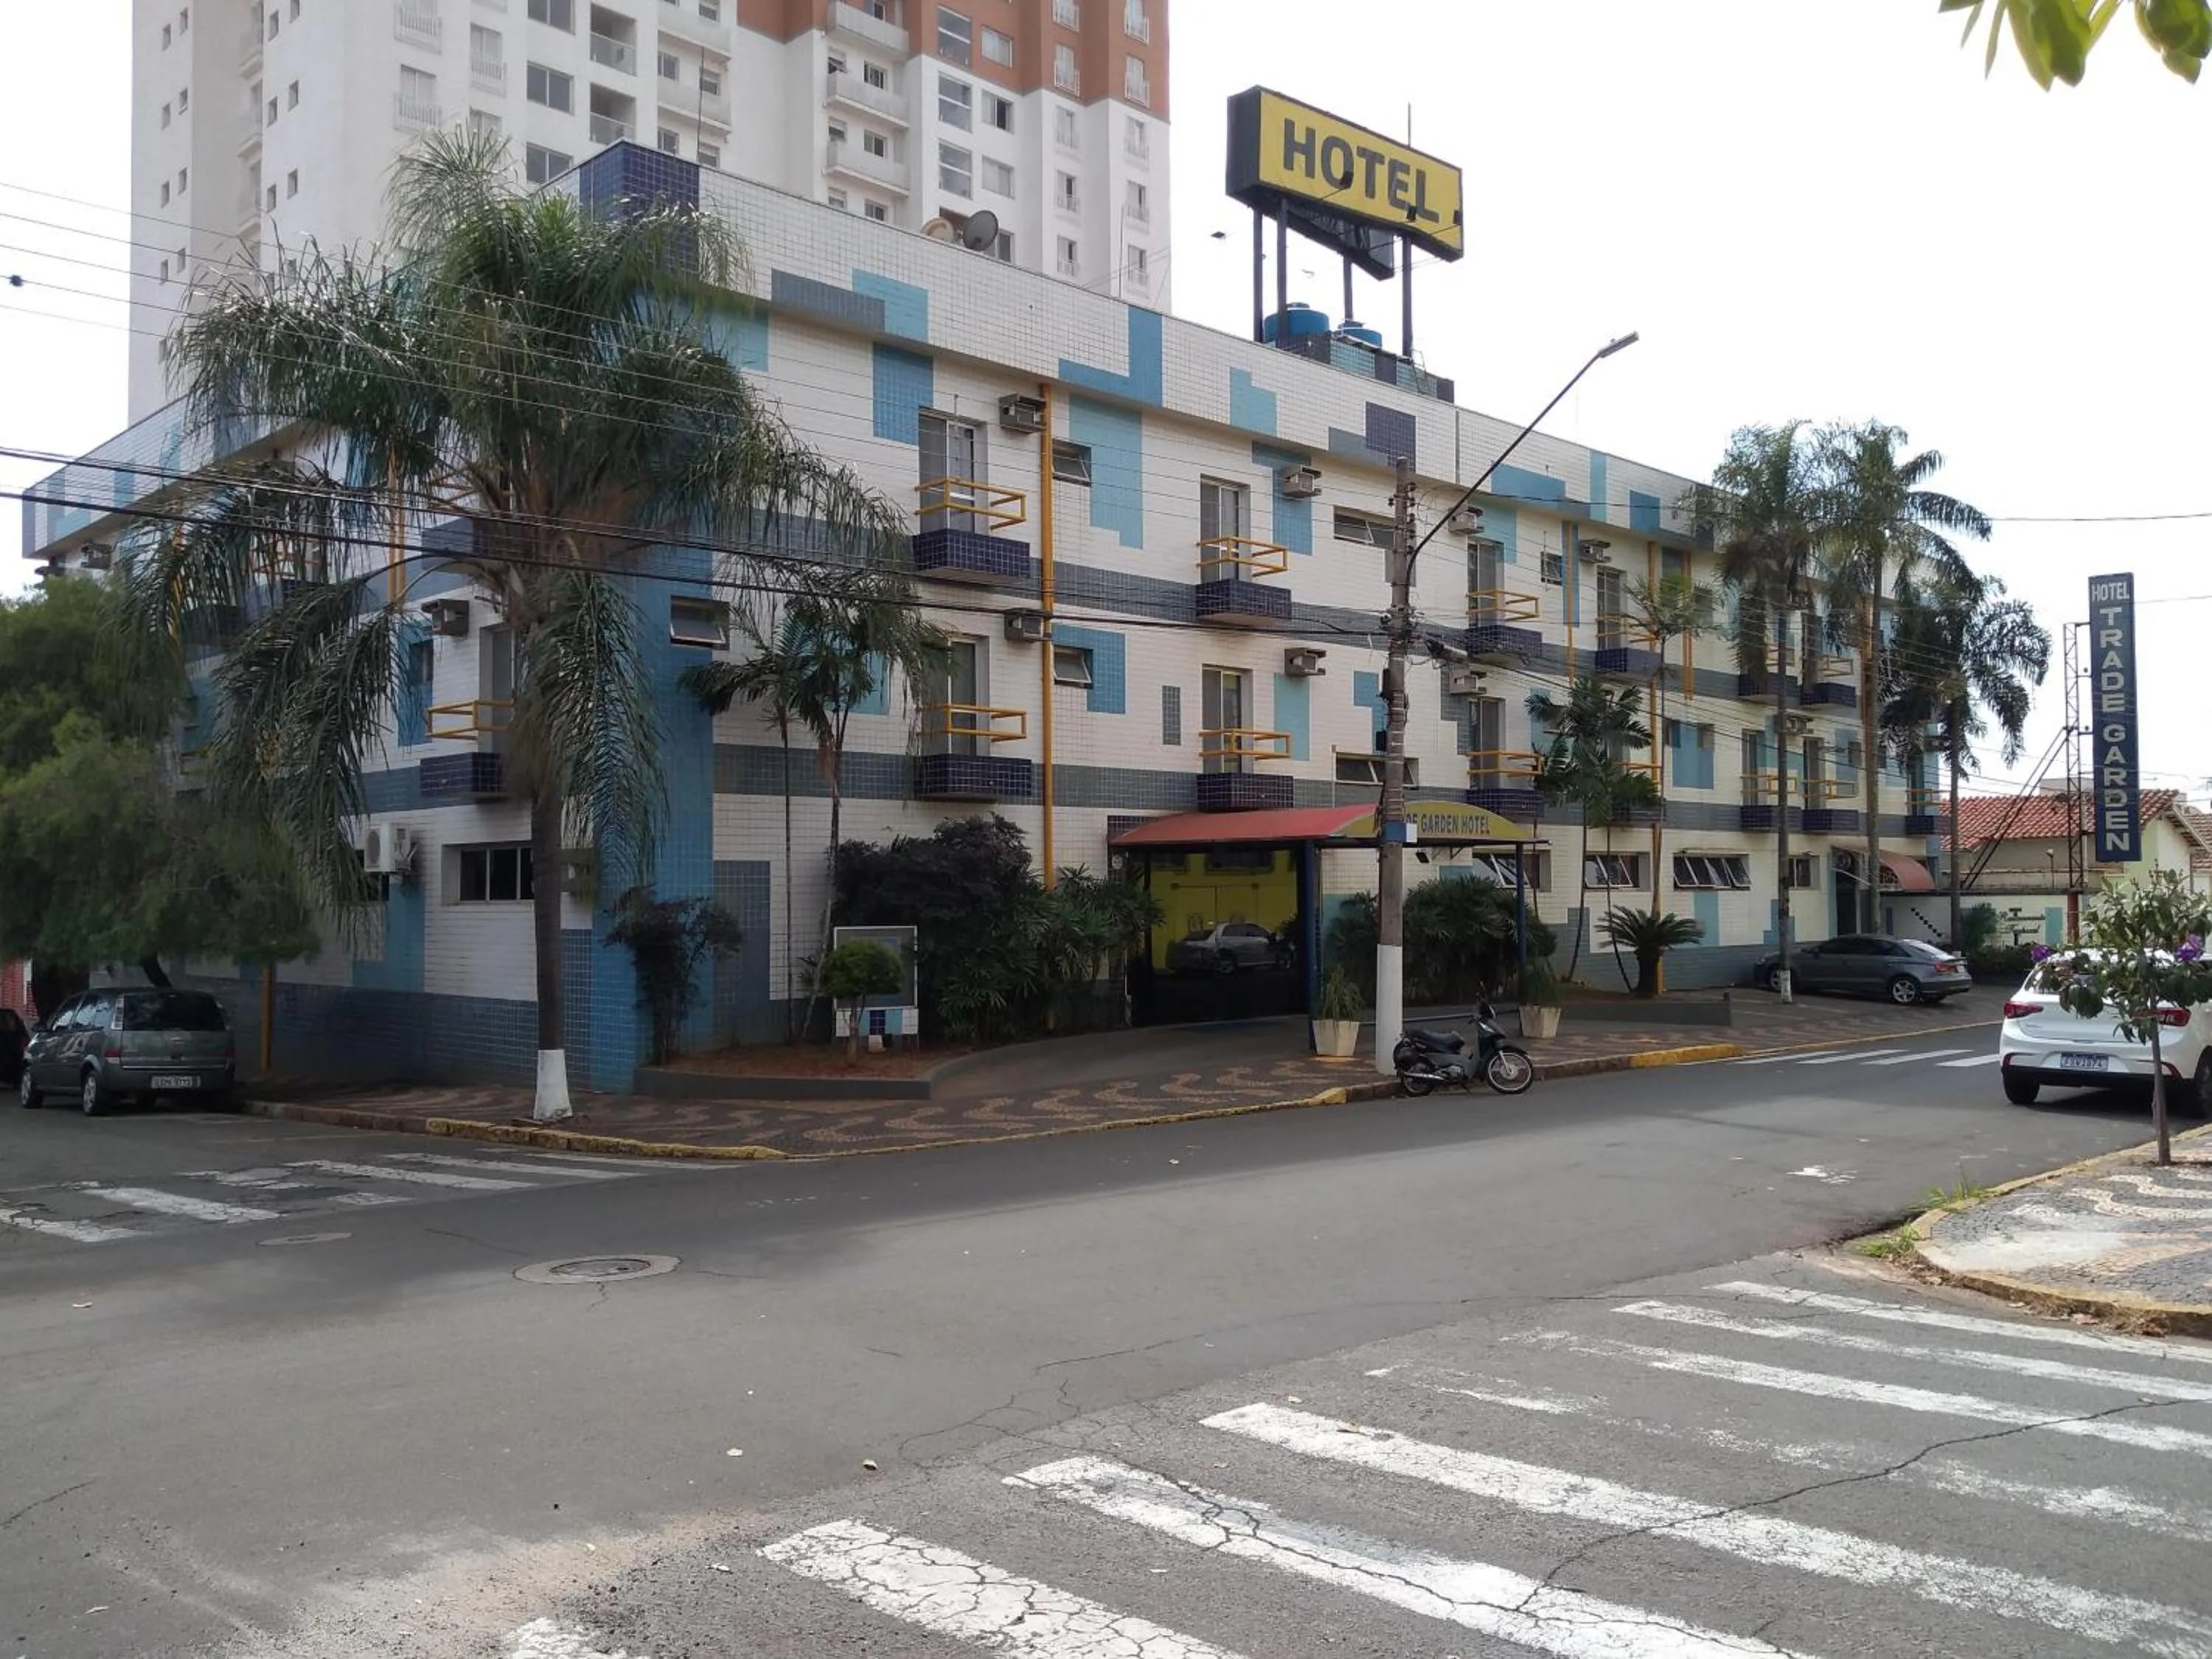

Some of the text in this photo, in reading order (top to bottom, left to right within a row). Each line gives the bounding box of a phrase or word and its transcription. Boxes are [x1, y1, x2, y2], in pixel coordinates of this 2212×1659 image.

[1284, 118, 1439, 223] HOTEL
[2092, 581, 2130, 601] HOTEL
[2098, 607, 2130, 852] TRADE GARDEN
[1421, 813, 1458, 834] GARDEN
[1461, 815, 1490, 835] HOTEL
